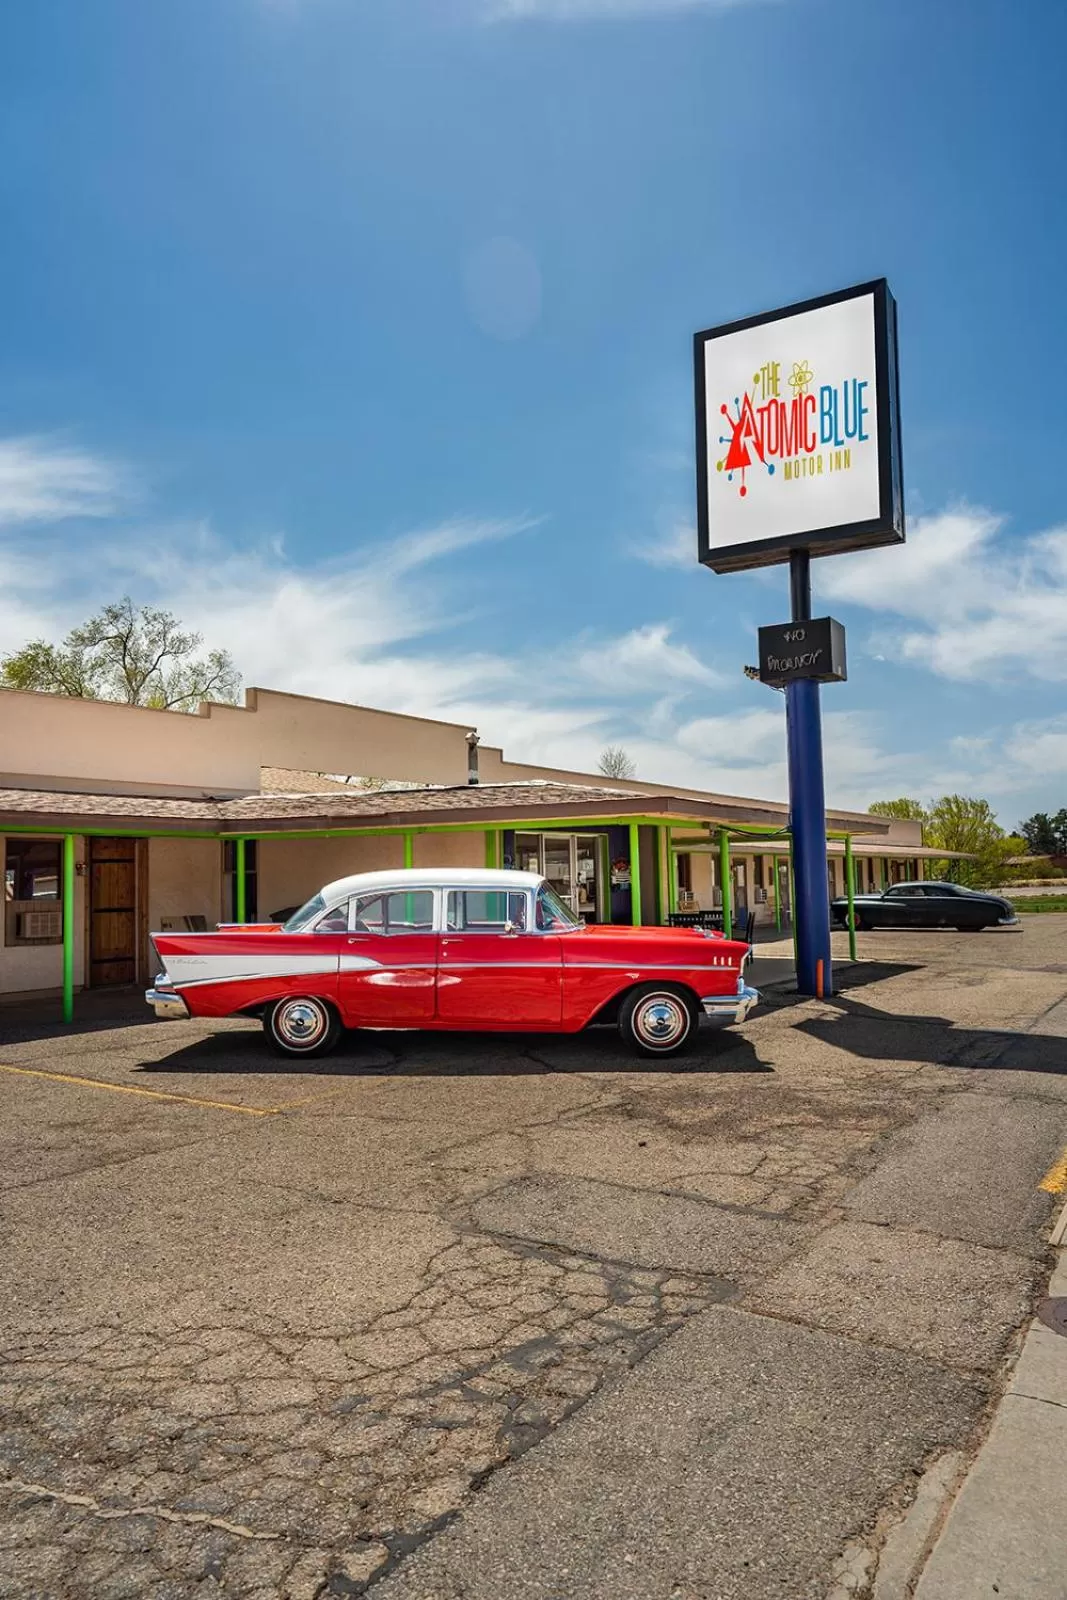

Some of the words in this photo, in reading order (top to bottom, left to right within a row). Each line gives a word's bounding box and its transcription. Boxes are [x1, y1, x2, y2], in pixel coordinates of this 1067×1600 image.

[760, 361, 780, 400] THE
[724, 391, 816, 471] ATOMIC
[820, 378, 869, 447] BLUE
[784, 454, 823, 480] MOTOR
[829, 448, 851, 472] INN
[784, 628, 806, 642] NO
